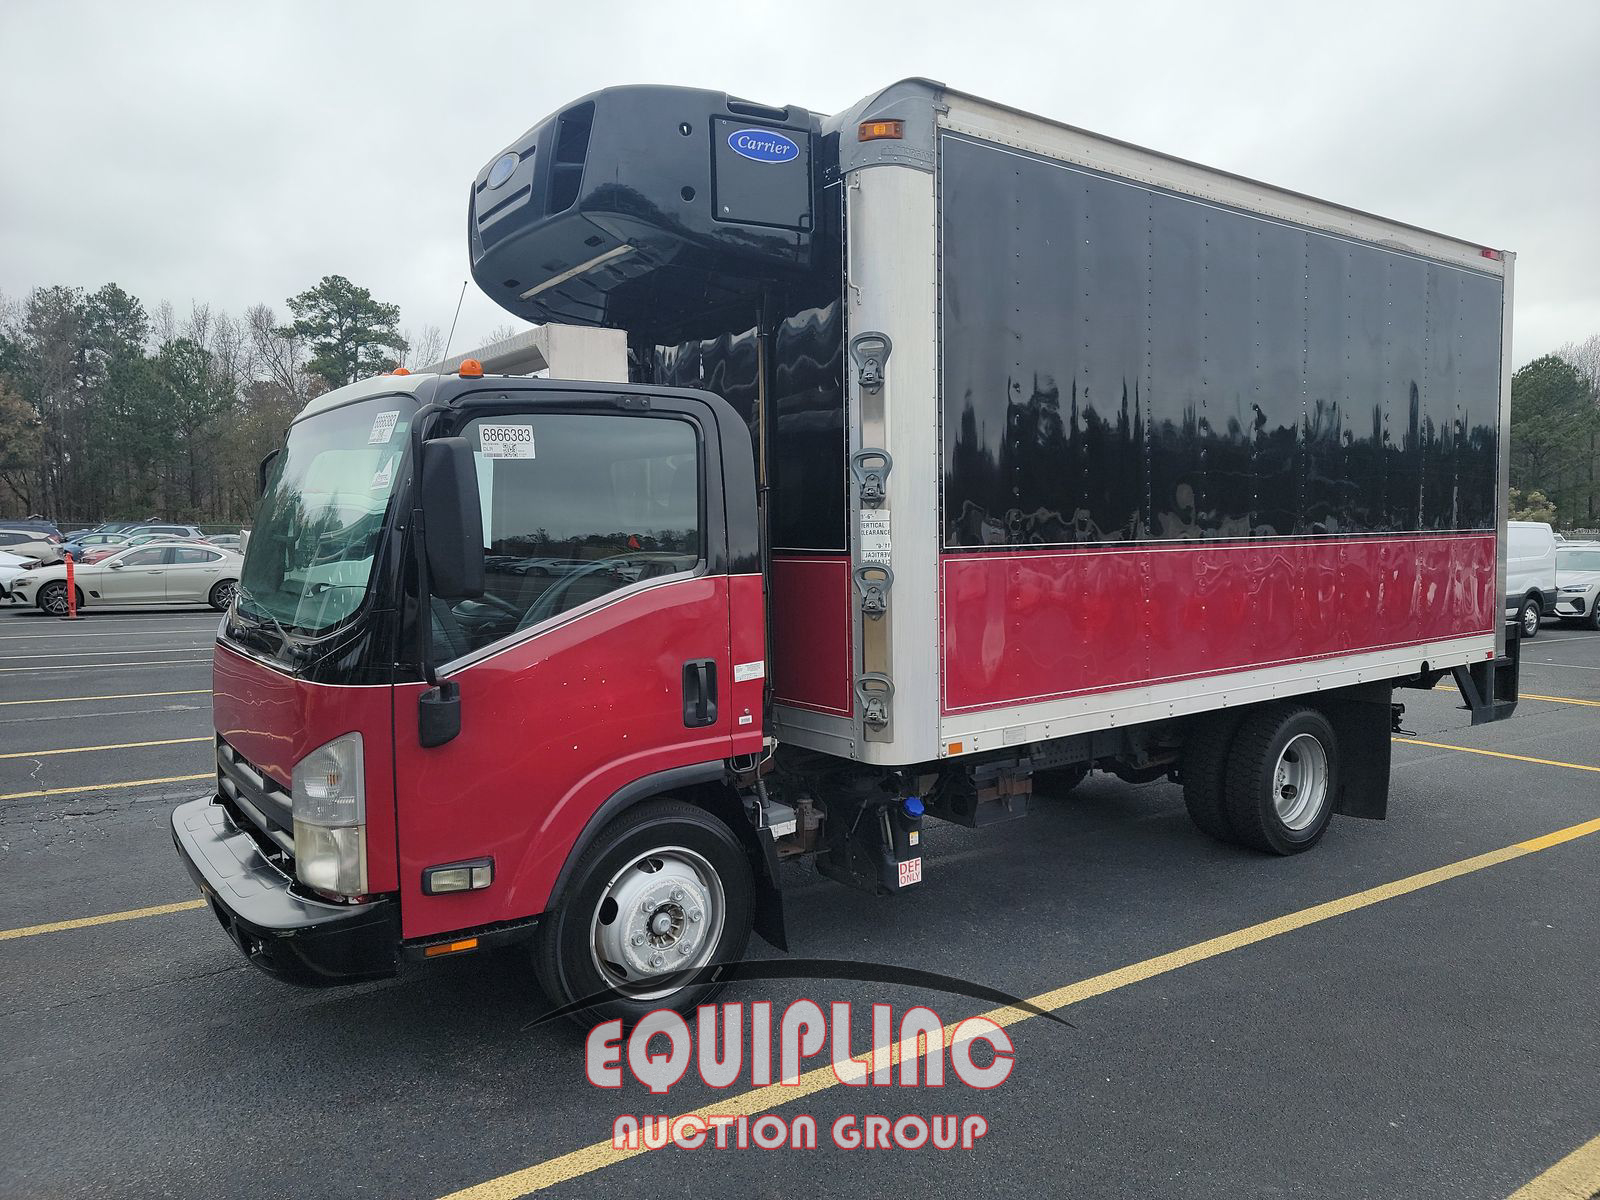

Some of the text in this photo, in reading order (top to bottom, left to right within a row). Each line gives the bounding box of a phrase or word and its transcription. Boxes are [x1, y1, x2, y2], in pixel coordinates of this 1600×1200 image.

[737, 135, 790, 155] Carrier
[483, 428, 531, 442] 6866383
[899, 859, 921, 875] DEF
[900, 872, 921, 885] ONLY
